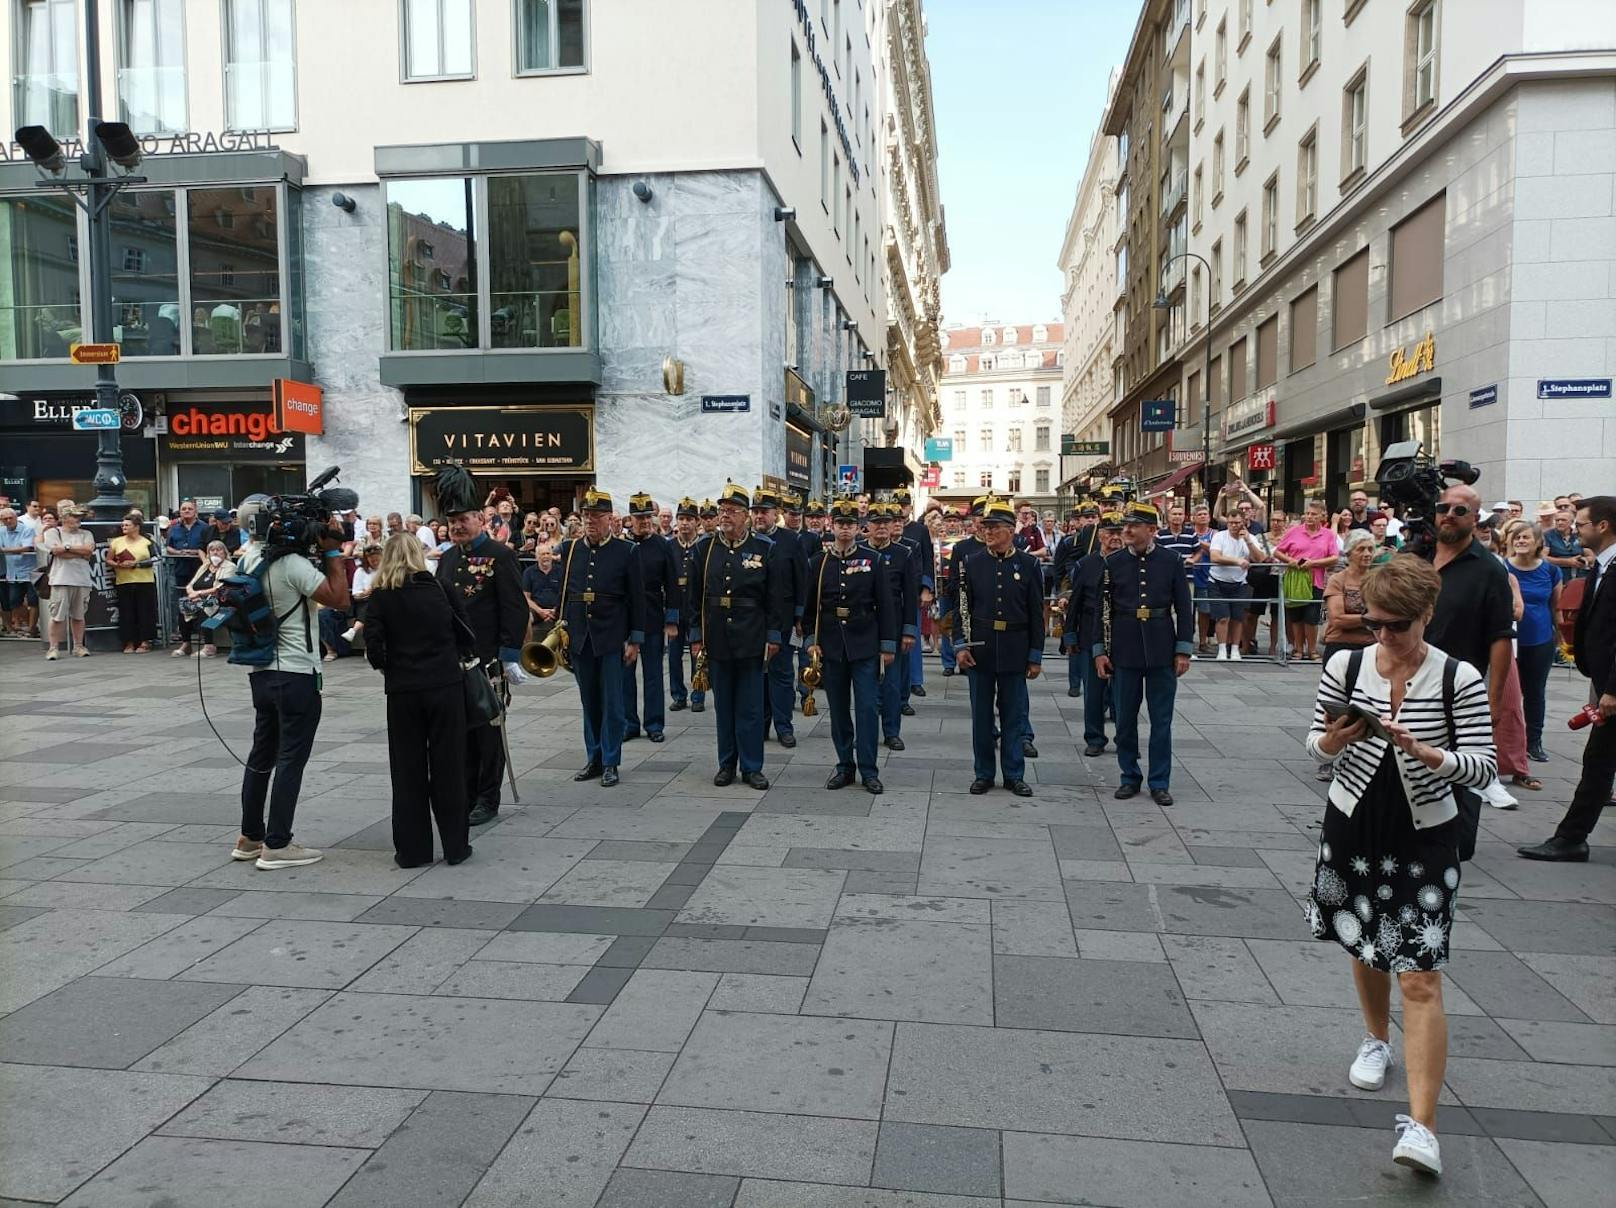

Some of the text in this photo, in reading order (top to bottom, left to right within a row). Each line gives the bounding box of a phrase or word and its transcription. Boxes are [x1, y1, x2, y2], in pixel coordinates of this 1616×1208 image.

[170, 128, 280, 154] ARAGALL
[1550, 383, 1607, 394] Stephansplatz
[287, 397, 319, 416] change
[849, 399, 882, 407] GIACOMO
[444, 432, 562, 448] VITAVIEN
